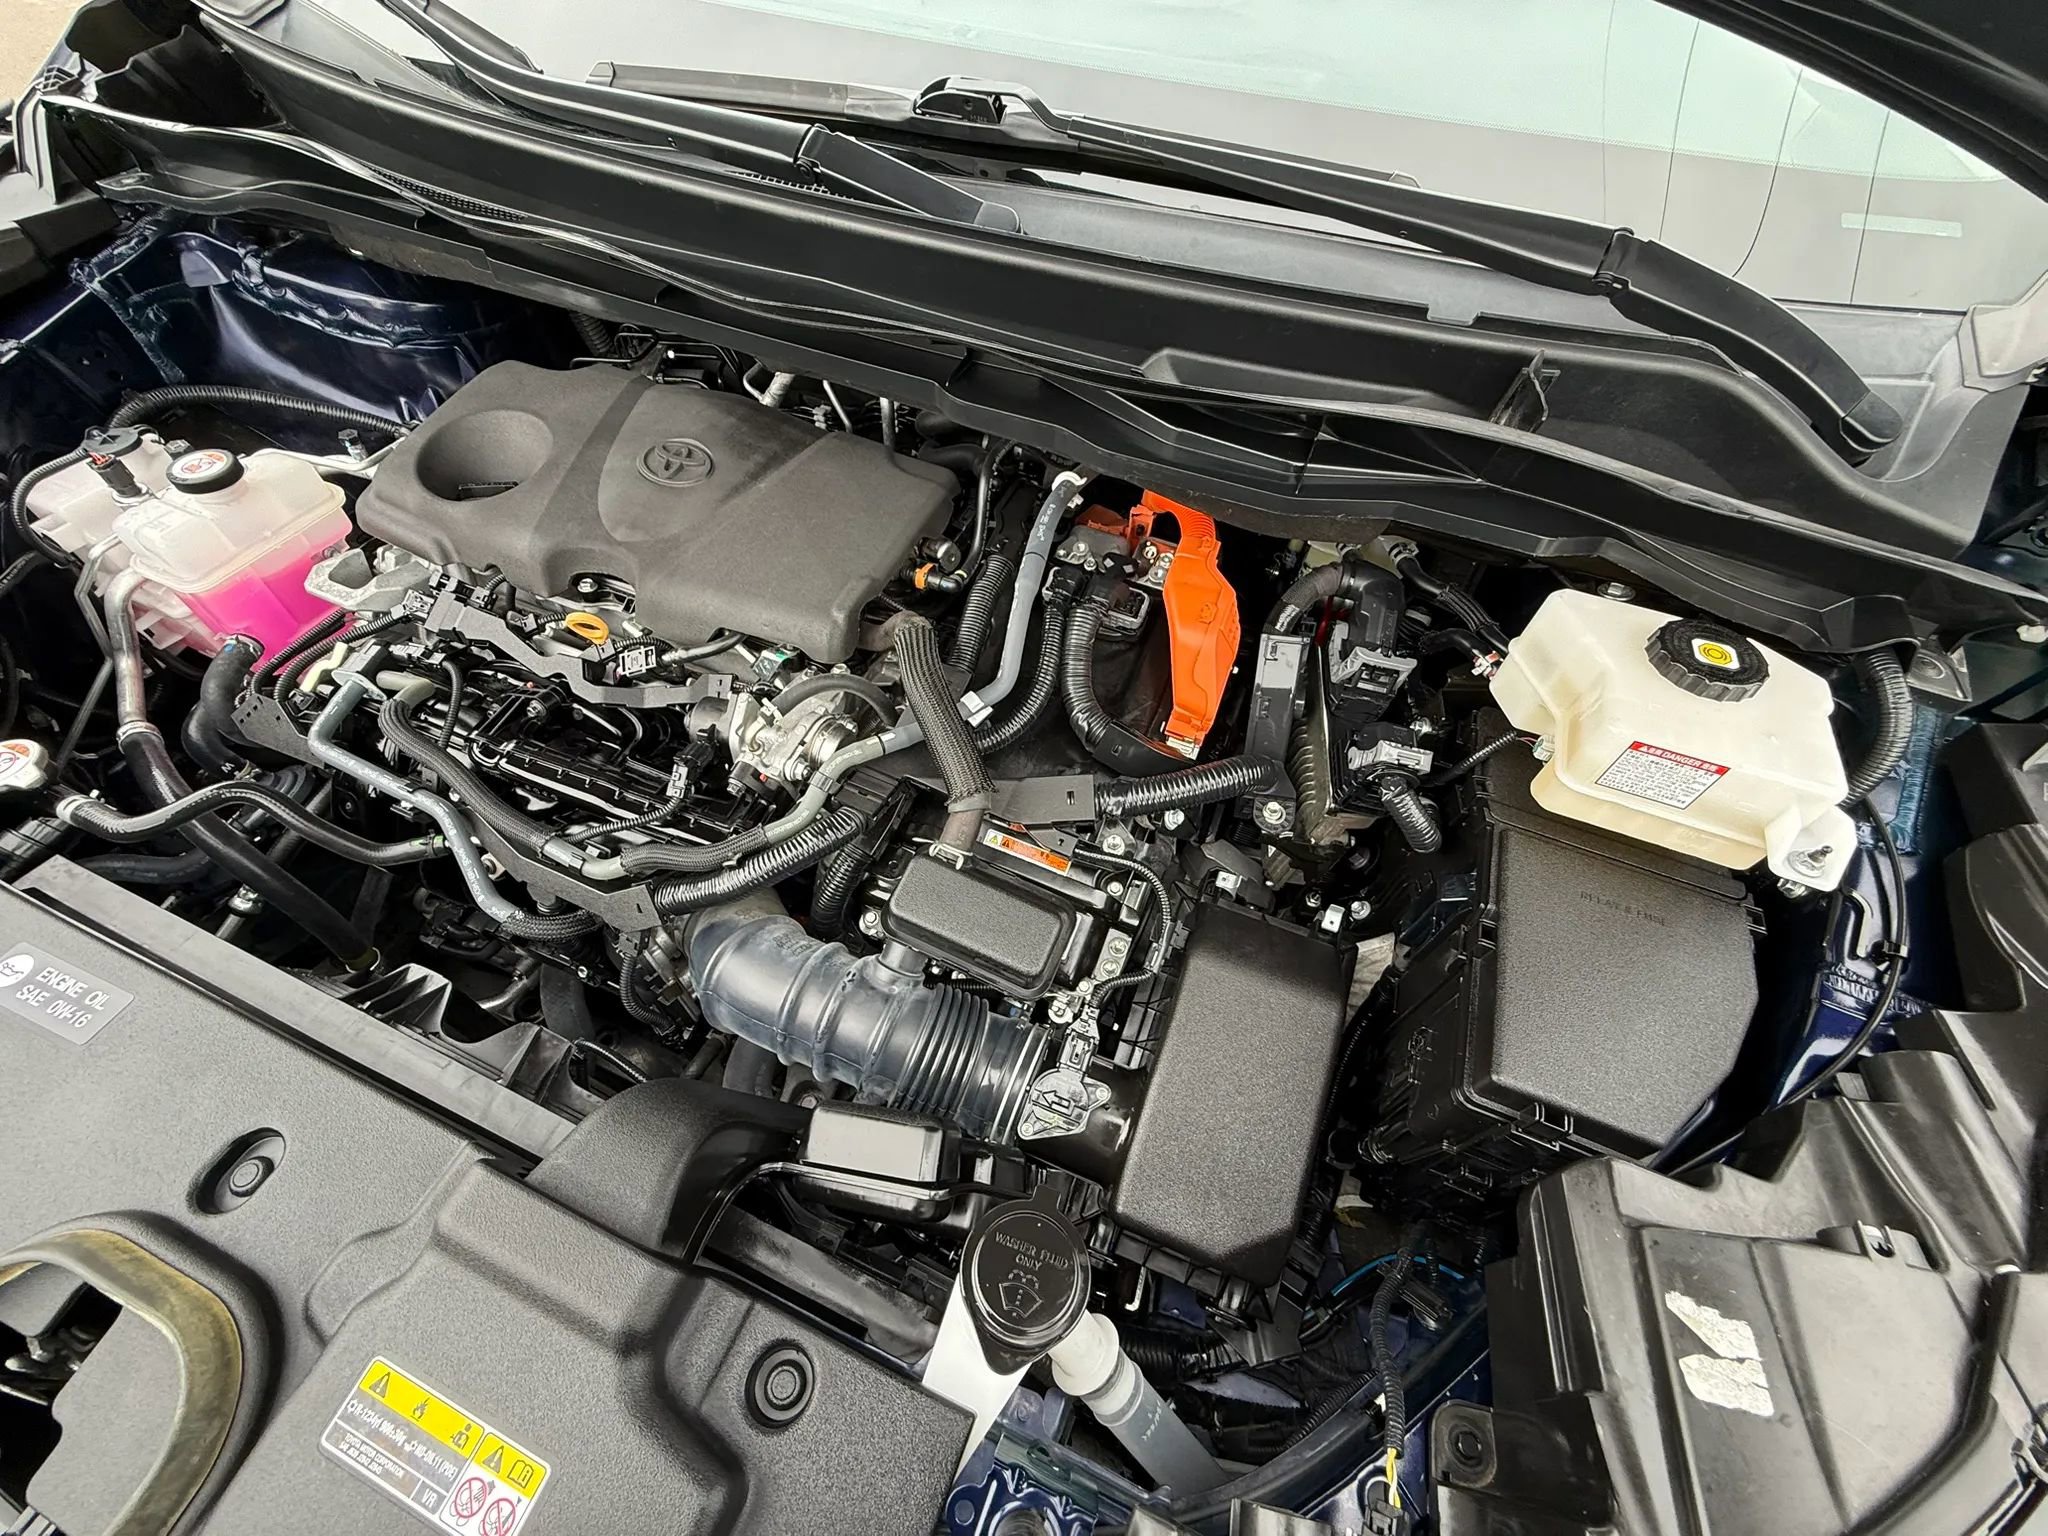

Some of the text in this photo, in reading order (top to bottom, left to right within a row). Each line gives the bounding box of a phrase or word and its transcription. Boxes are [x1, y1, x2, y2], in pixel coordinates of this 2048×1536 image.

[1661, 751, 1701, 767] DANGER
[16, 985, 93, 1027] SAE 0W-16
[36, 967, 110, 1010] ENGINE OIL
[995, 1232, 1068, 1269] WASHER FLUID
[1015, 1253, 1043, 1271] ONLY
[344, 1432, 405, 1478] TOYOTA MOTOR CORPORATION
[422, 1488, 438, 1508] VR
